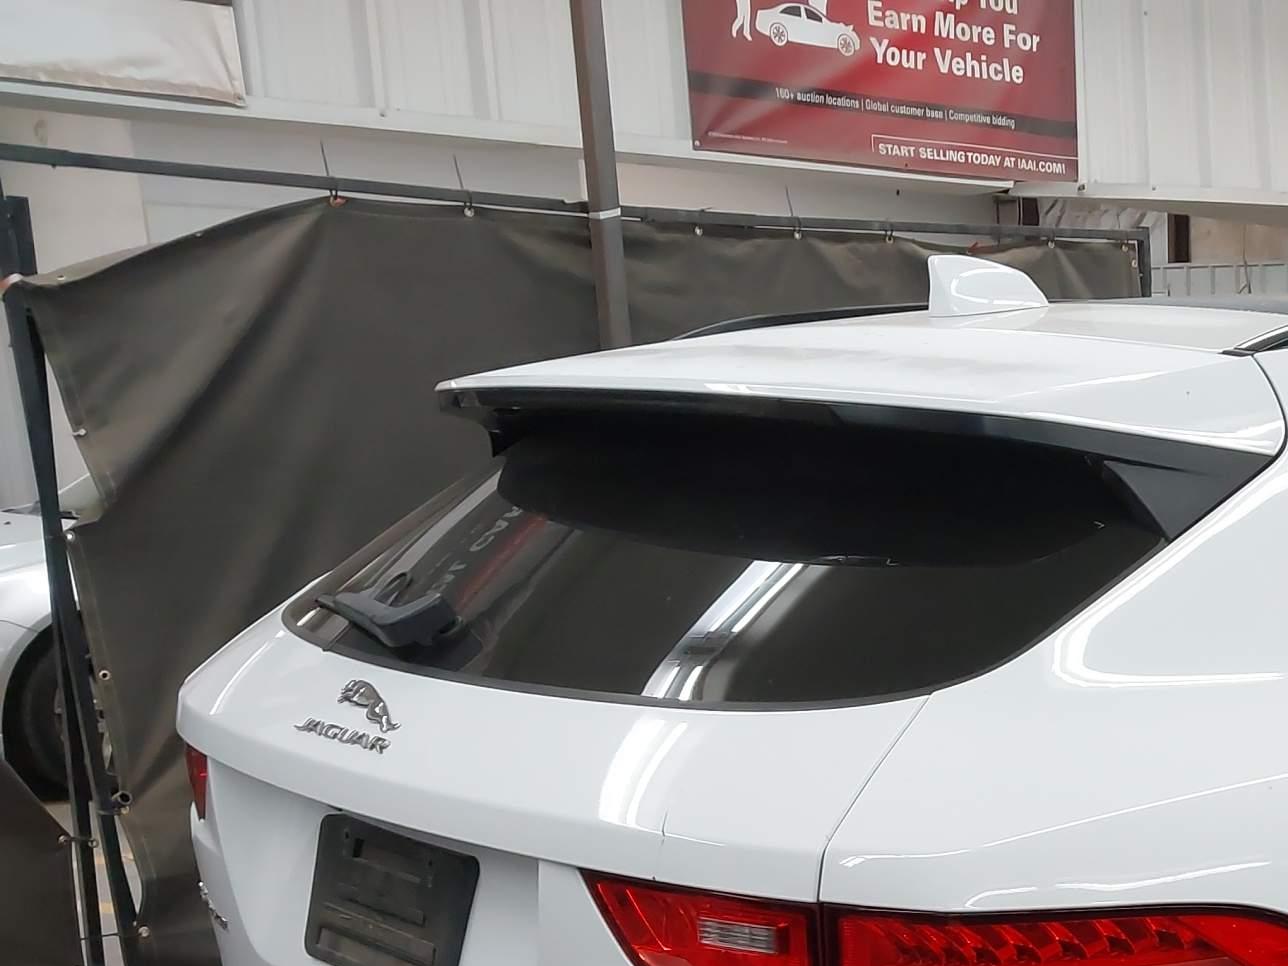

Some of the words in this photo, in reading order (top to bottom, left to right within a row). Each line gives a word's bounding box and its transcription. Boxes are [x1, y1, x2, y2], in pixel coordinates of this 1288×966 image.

[868, 0, 927, 34] Earn
[933, 11, 995, 46] More
[1003, 24, 1041, 52] For
[869, 37, 927, 71] Your
[934, 47, 1024, 84] Vehicle
[796, 91, 825, 105] auction
[825, 93, 860, 110] locations
[865, 98, 889, 113] Global
[890, 104, 925, 118] customer
[948, 109, 991, 126] Competitive
[991, 114, 1015, 130] bidding
[878, 143, 915, 158] START
[919, 147, 966, 164] SELLING
[967, 151, 1002, 168] TODAY
[1003, 156, 1018, 169] AT
[293, 717, 391, 754] JAGUAR
